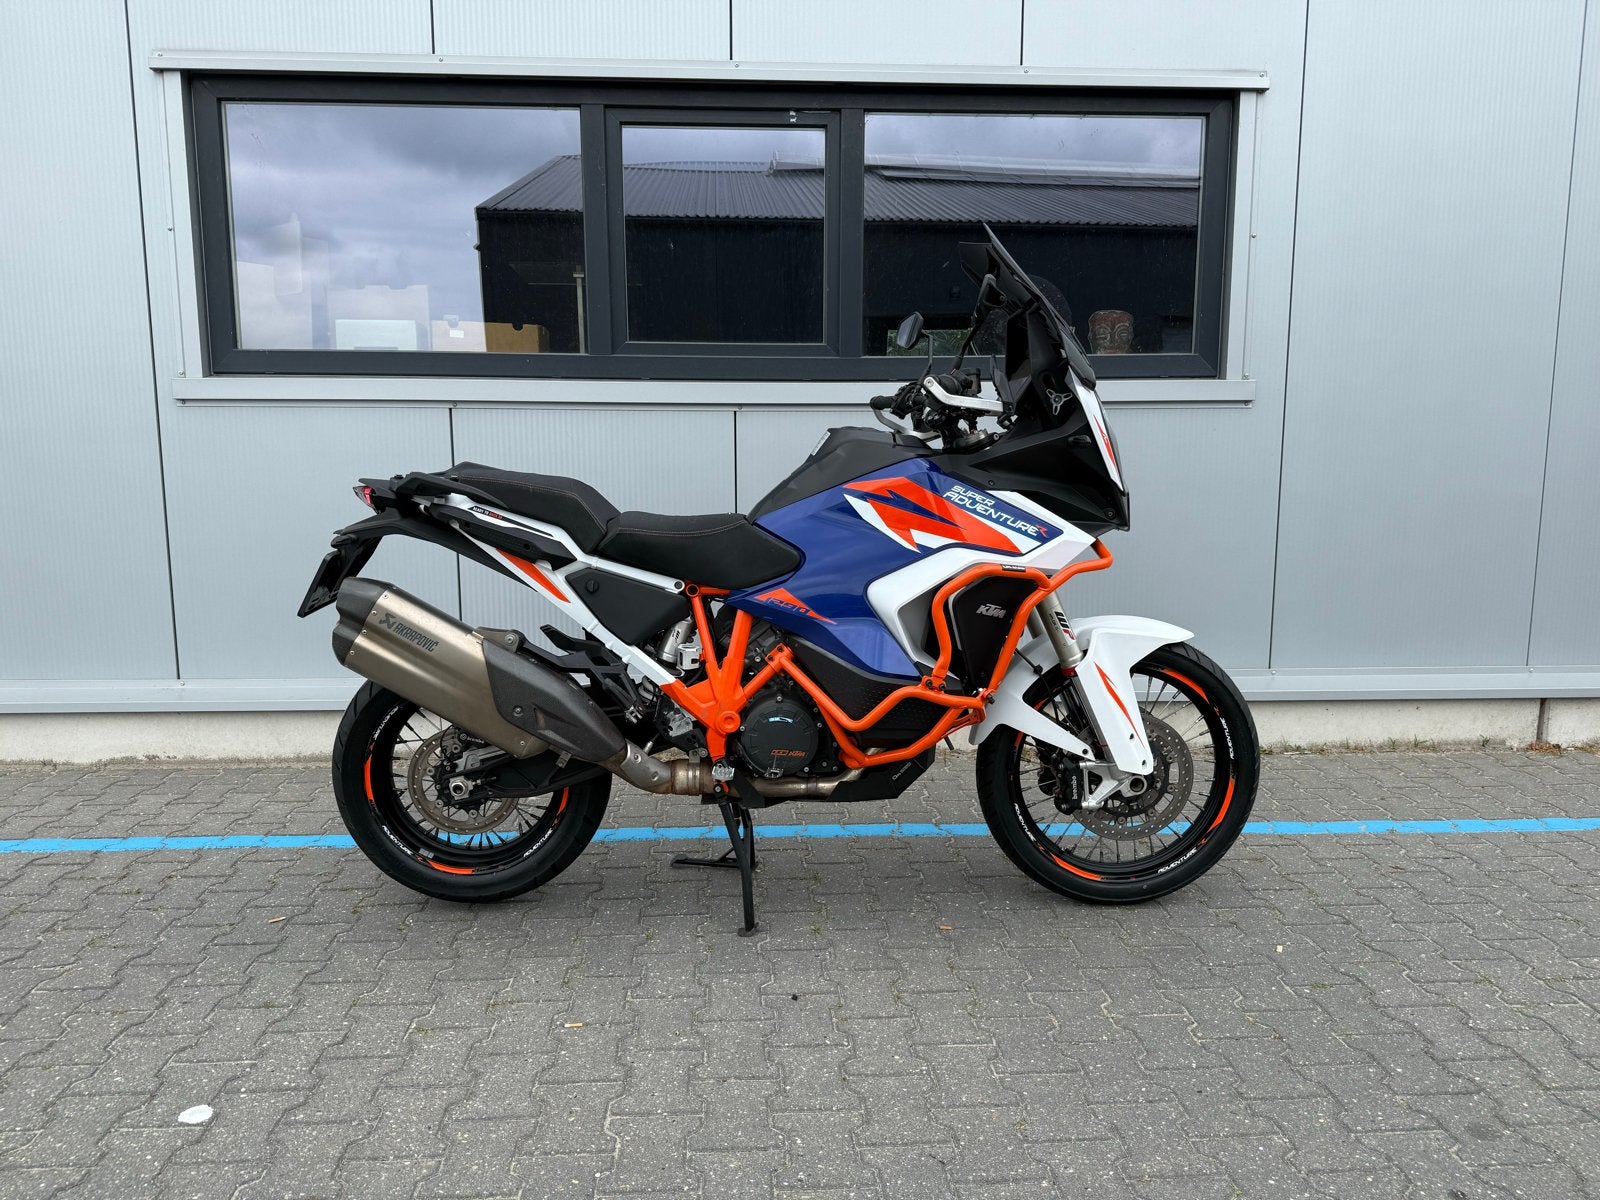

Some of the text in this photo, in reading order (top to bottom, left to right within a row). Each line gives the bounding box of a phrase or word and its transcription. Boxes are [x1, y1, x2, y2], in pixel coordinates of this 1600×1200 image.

[950, 485, 996, 507] SUPER
[976, 603, 1007, 618] KTM
[1055, 611, 1075, 640] WP
[1157, 846, 1198, 874] ADVENTURE
